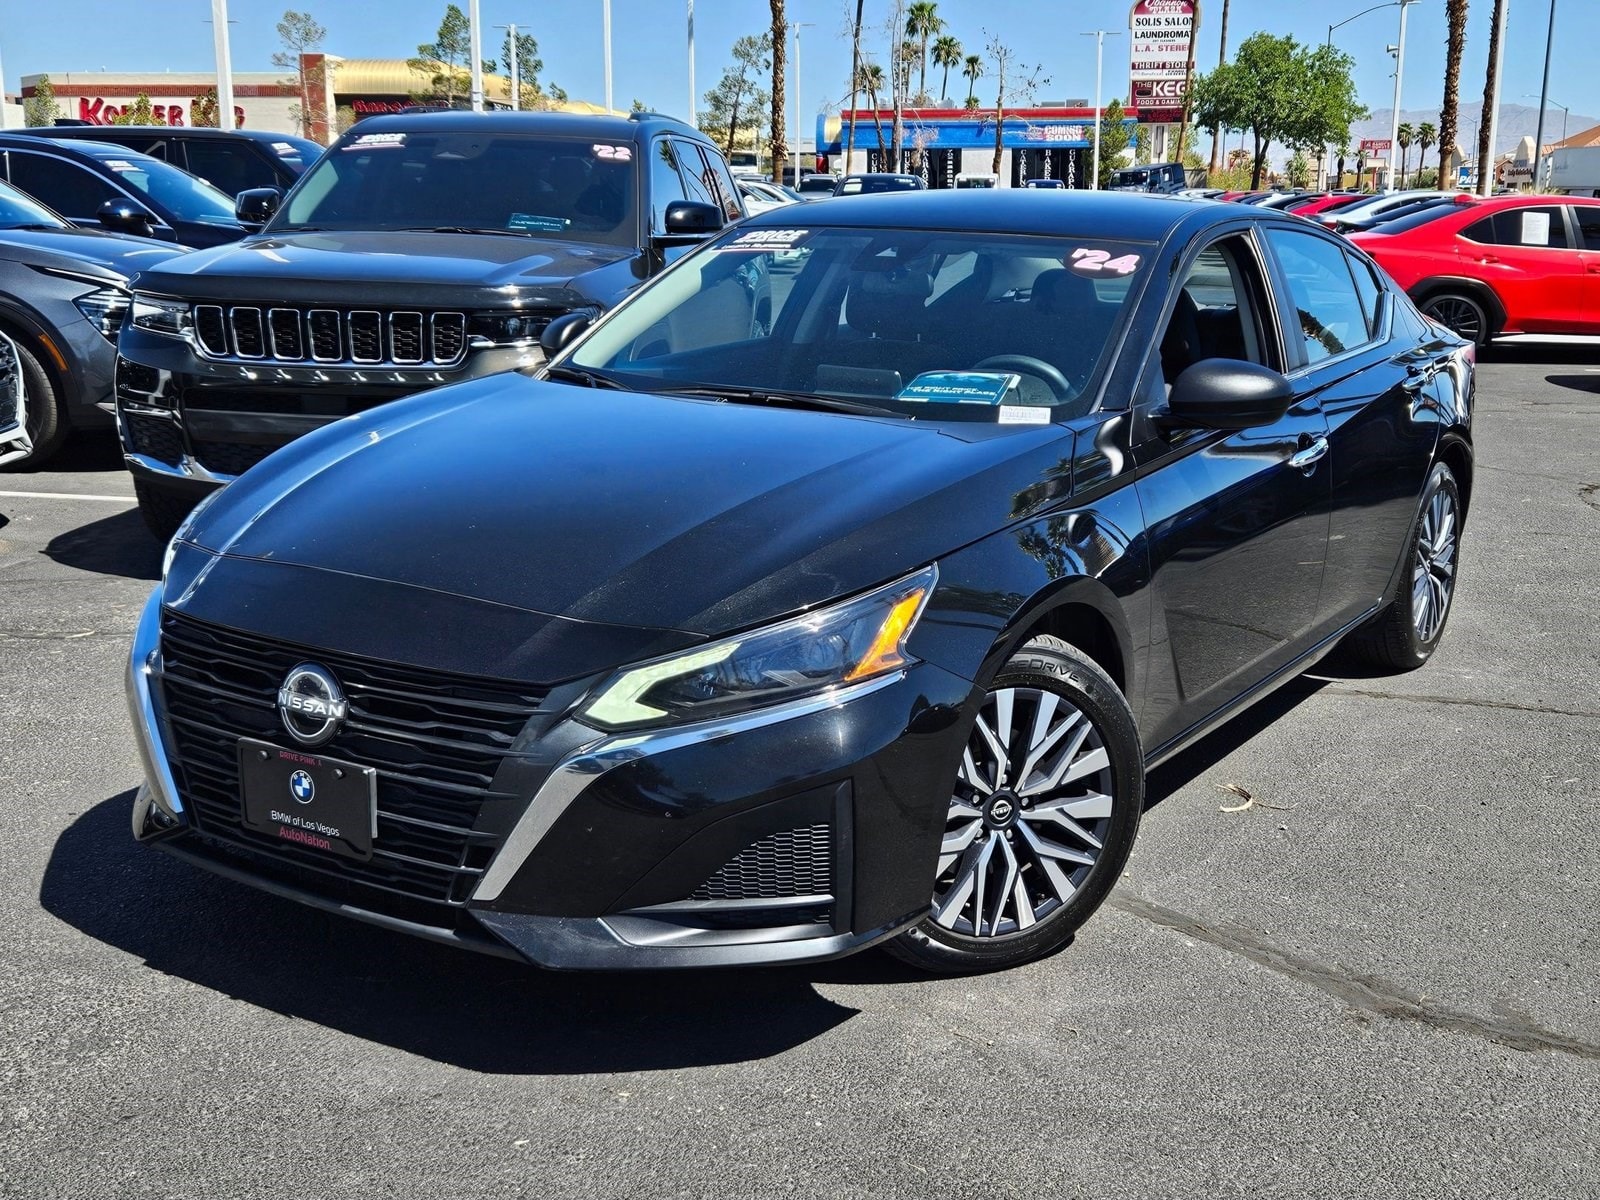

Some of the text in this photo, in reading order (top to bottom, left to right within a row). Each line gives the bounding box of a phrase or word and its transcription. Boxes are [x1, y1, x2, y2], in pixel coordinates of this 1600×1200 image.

[1135, 17, 1162, 26] SOLIS
[1165, 61, 1187, 69] STOR
[1152, 80, 1186, 97] KEG
[1045, 134, 1081, 142] SOON
[278, 691, 342, 717] NISSAN
[279, 750, 316, 766] DRIVE PINK
[271, 810, 340, 837] BMW of Las Vegas
[279, 826, 331, 850] AutoNation
